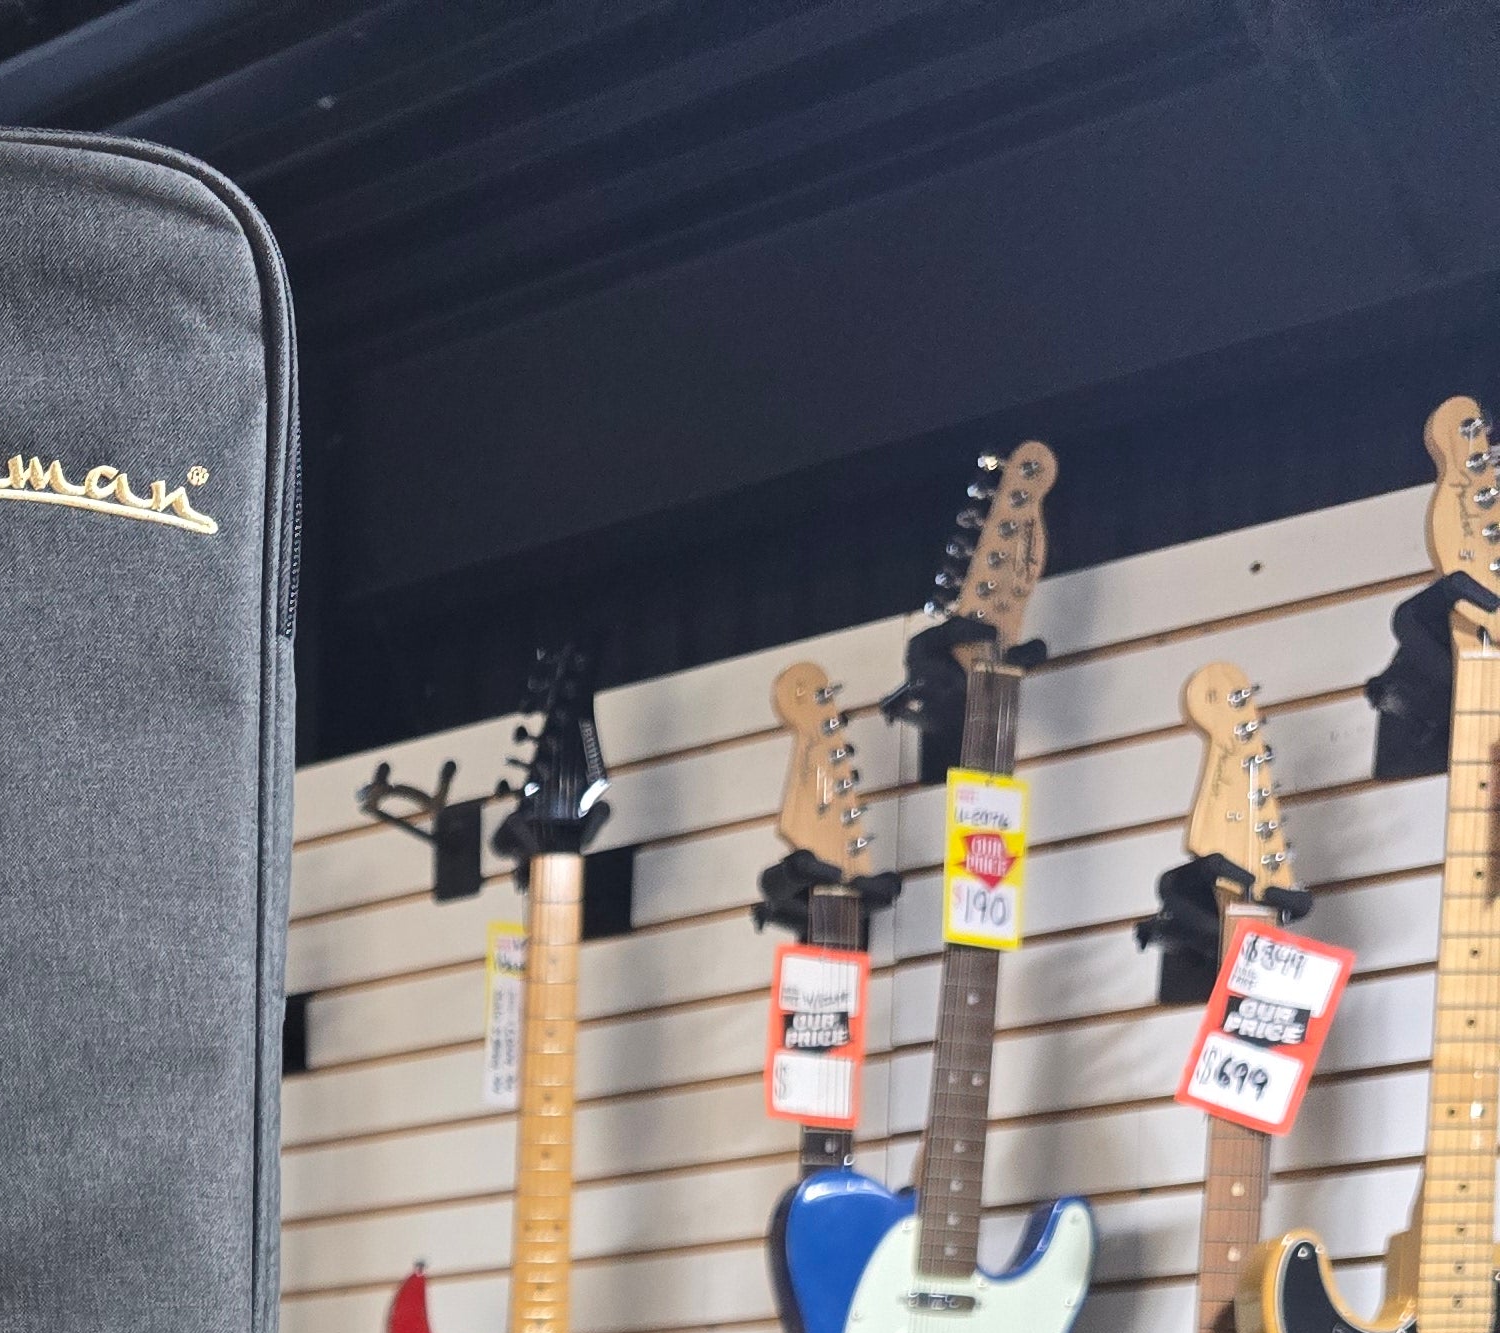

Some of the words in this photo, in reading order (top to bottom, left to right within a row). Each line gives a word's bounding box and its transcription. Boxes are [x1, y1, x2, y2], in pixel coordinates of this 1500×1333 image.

[1239, 999, 1296, 1023] OUR
[793, 1013, 836, 1032] OUR
[1223, 1011, 1305, 1045] PRICE
[785, 1028, 850, 1048] PRICE
